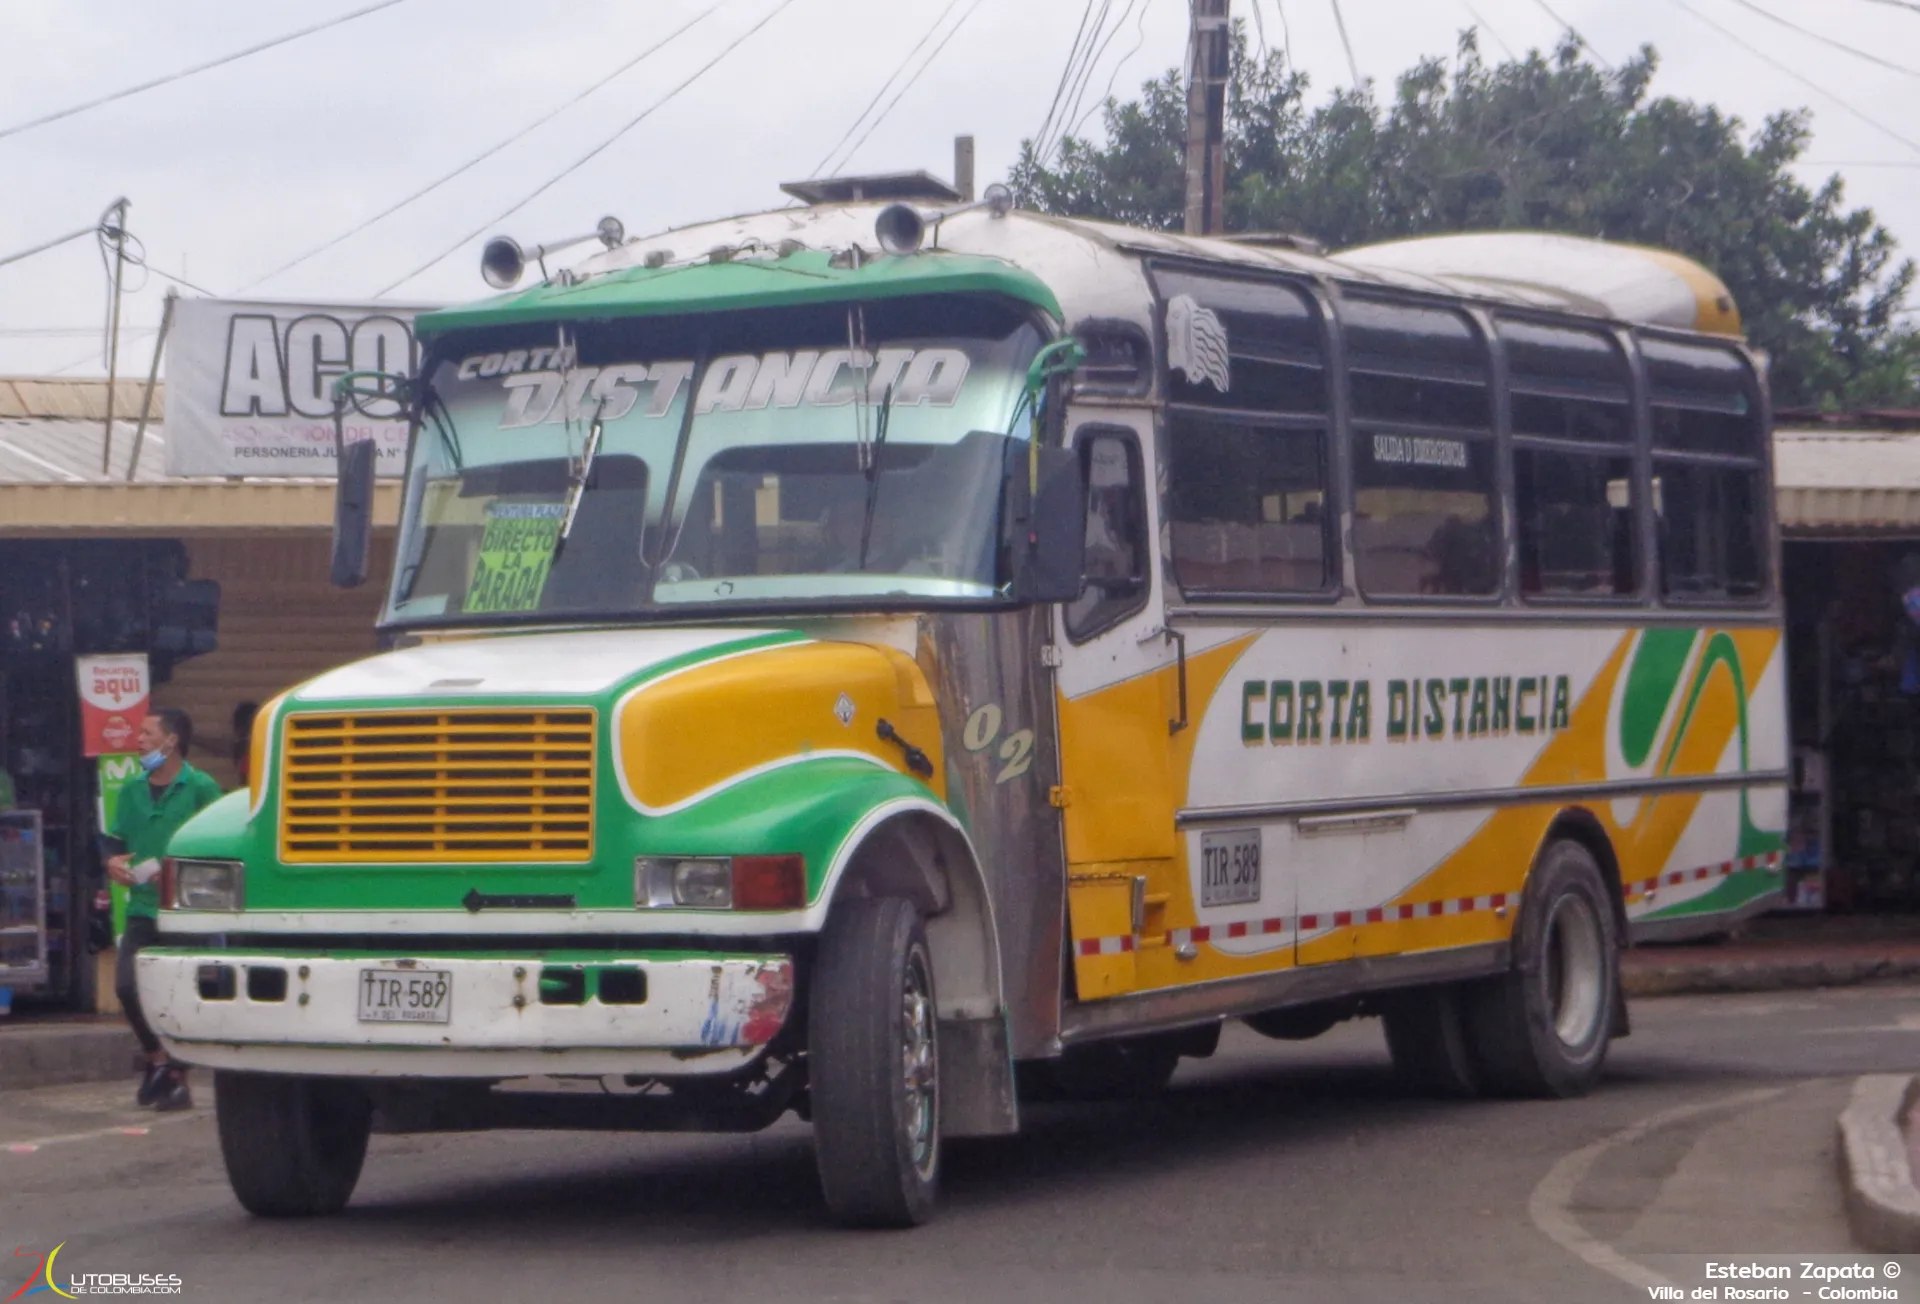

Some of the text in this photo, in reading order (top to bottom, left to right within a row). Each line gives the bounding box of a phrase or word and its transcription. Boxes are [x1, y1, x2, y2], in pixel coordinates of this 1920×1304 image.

[457, 345, 576, 381] CORTA
[499, 348, 971, 430] DISTANCIA
[234, 446, 319, 459] PERSONERIA
[483, 528, 555, 552] DIRECTO
[502, 551, 522, 569] LA
[469, 557, 544, 610] PARADA
[1241, 674, 1570, 748] CORTA DISTANCIA
[963, 703, 1034, 785] 02
